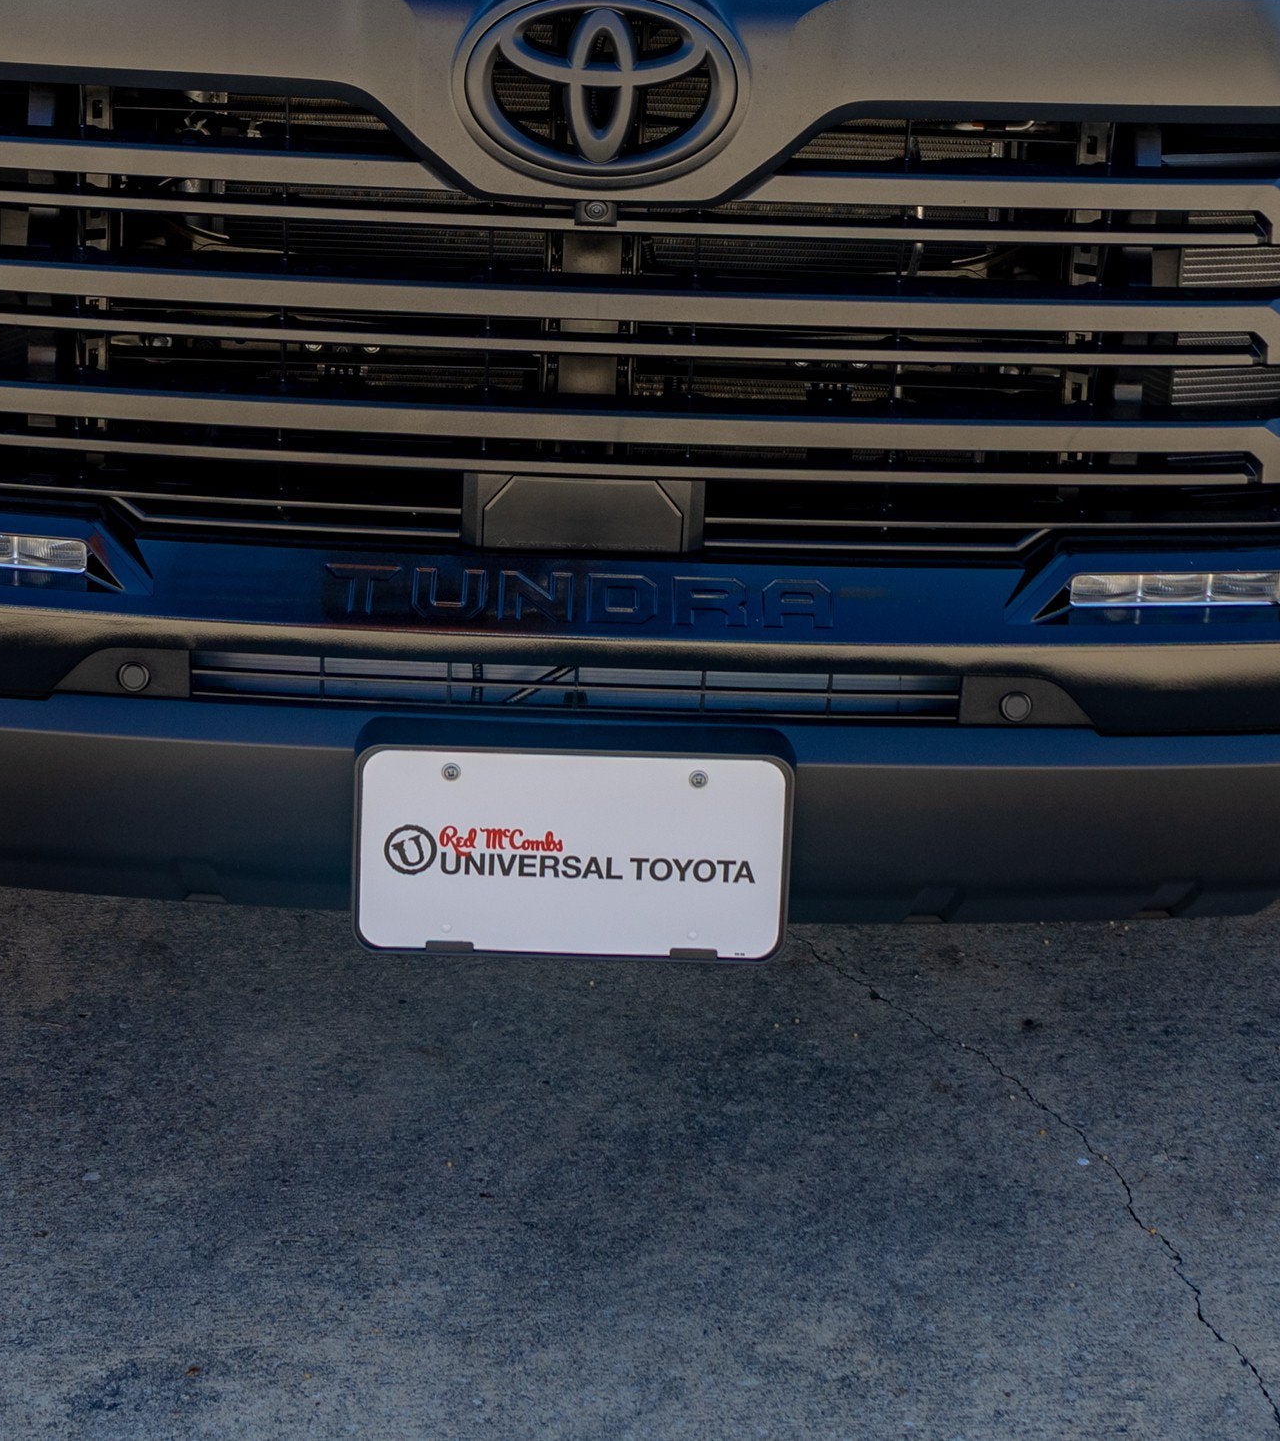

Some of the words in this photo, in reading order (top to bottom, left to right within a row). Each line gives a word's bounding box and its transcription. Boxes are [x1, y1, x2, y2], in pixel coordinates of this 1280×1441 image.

[324, 562, 835, 629] TUNDRA
[439, 825, 477, 857] Red
[480, 827, 564, 853] McCombs
[440, 851, 623, 880] UNIVERSAL
[630, 857, 756, 884] TOYOTA
